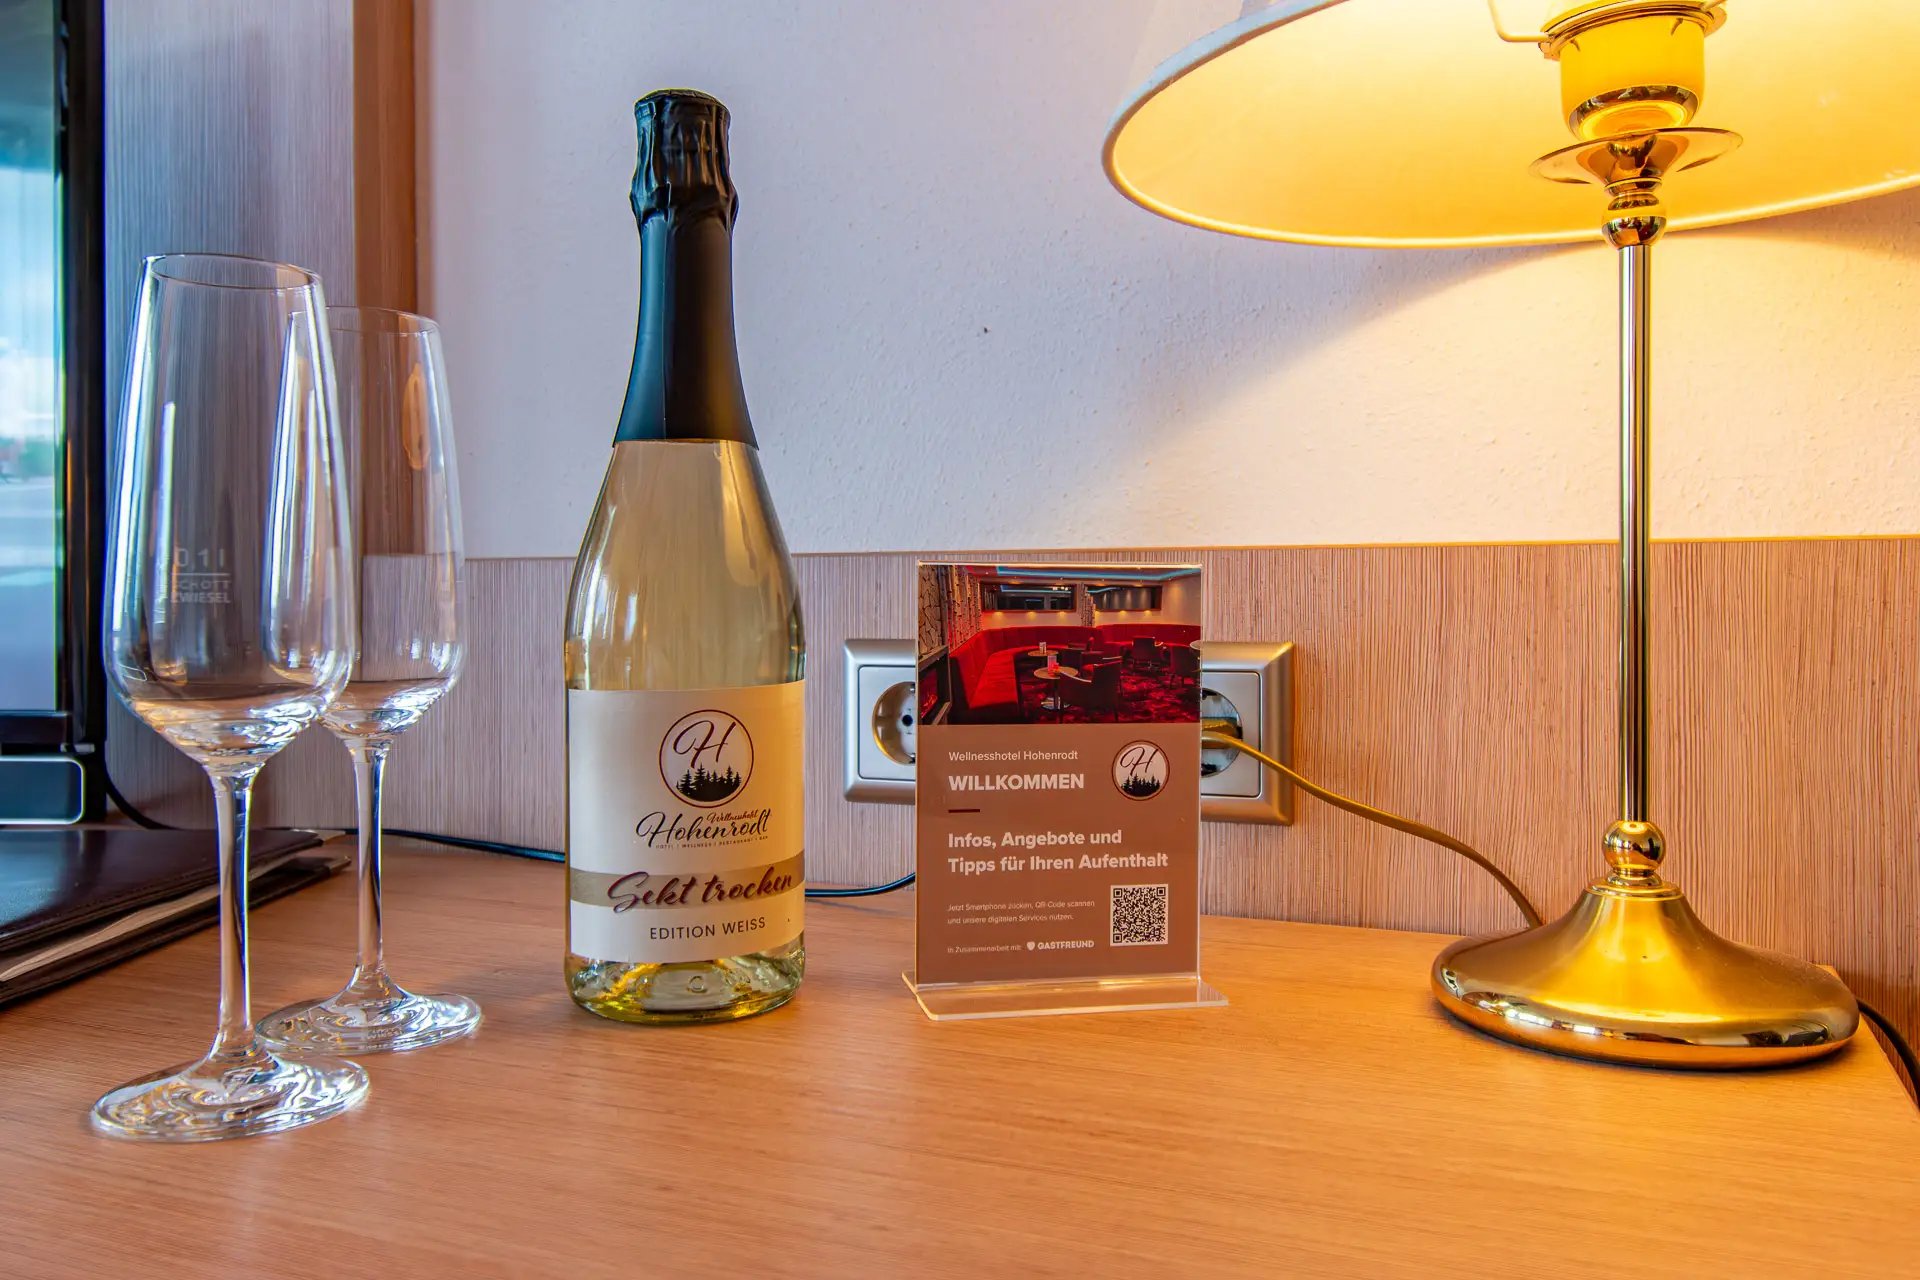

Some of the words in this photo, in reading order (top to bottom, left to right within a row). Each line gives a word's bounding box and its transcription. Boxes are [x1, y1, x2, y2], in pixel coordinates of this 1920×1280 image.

[948, 750, 1021, 761] Wellnesshotel
[1023, 750, 1079, 761] Hohenrodt
[948, 773, 1085, 791] WILLKOMMEN
[635, 808, 772, 848] Hohenrodt
[948, 833, 997, 849] Infos,
[1001, 831, 1085, 849] Angebote
[1090, 830, 1122, 844] und
[948, 857, 996, 876] Tipps
[1000, 856, 1026, 871] für
[1030, 855, 1074, 870] Ihren
[1078, 853, 1169, 869] Aufenthalt
[607, 871, 699, 914] Sekt
[701, 866, 793, 905] trocken
[947, 904, 964, 912] Jetzt
[965, 903, 1007, 912] Smartphone
[1067, 900, 1095, 908] scannen
[947, 917, 961, 925] und
[988, 914, 1018, 924] digitalen
[1018, 914, 1048, 922] Services
[1049, 913, 1074, 921] nutzen.
[650, 924, 716, 940] EDITION
[722, 917, 767, 934] WEISS
[955, 944, 1009, 954] Zusammenarbeit
[1037, 939, 1095, 950] GASTFREUND
